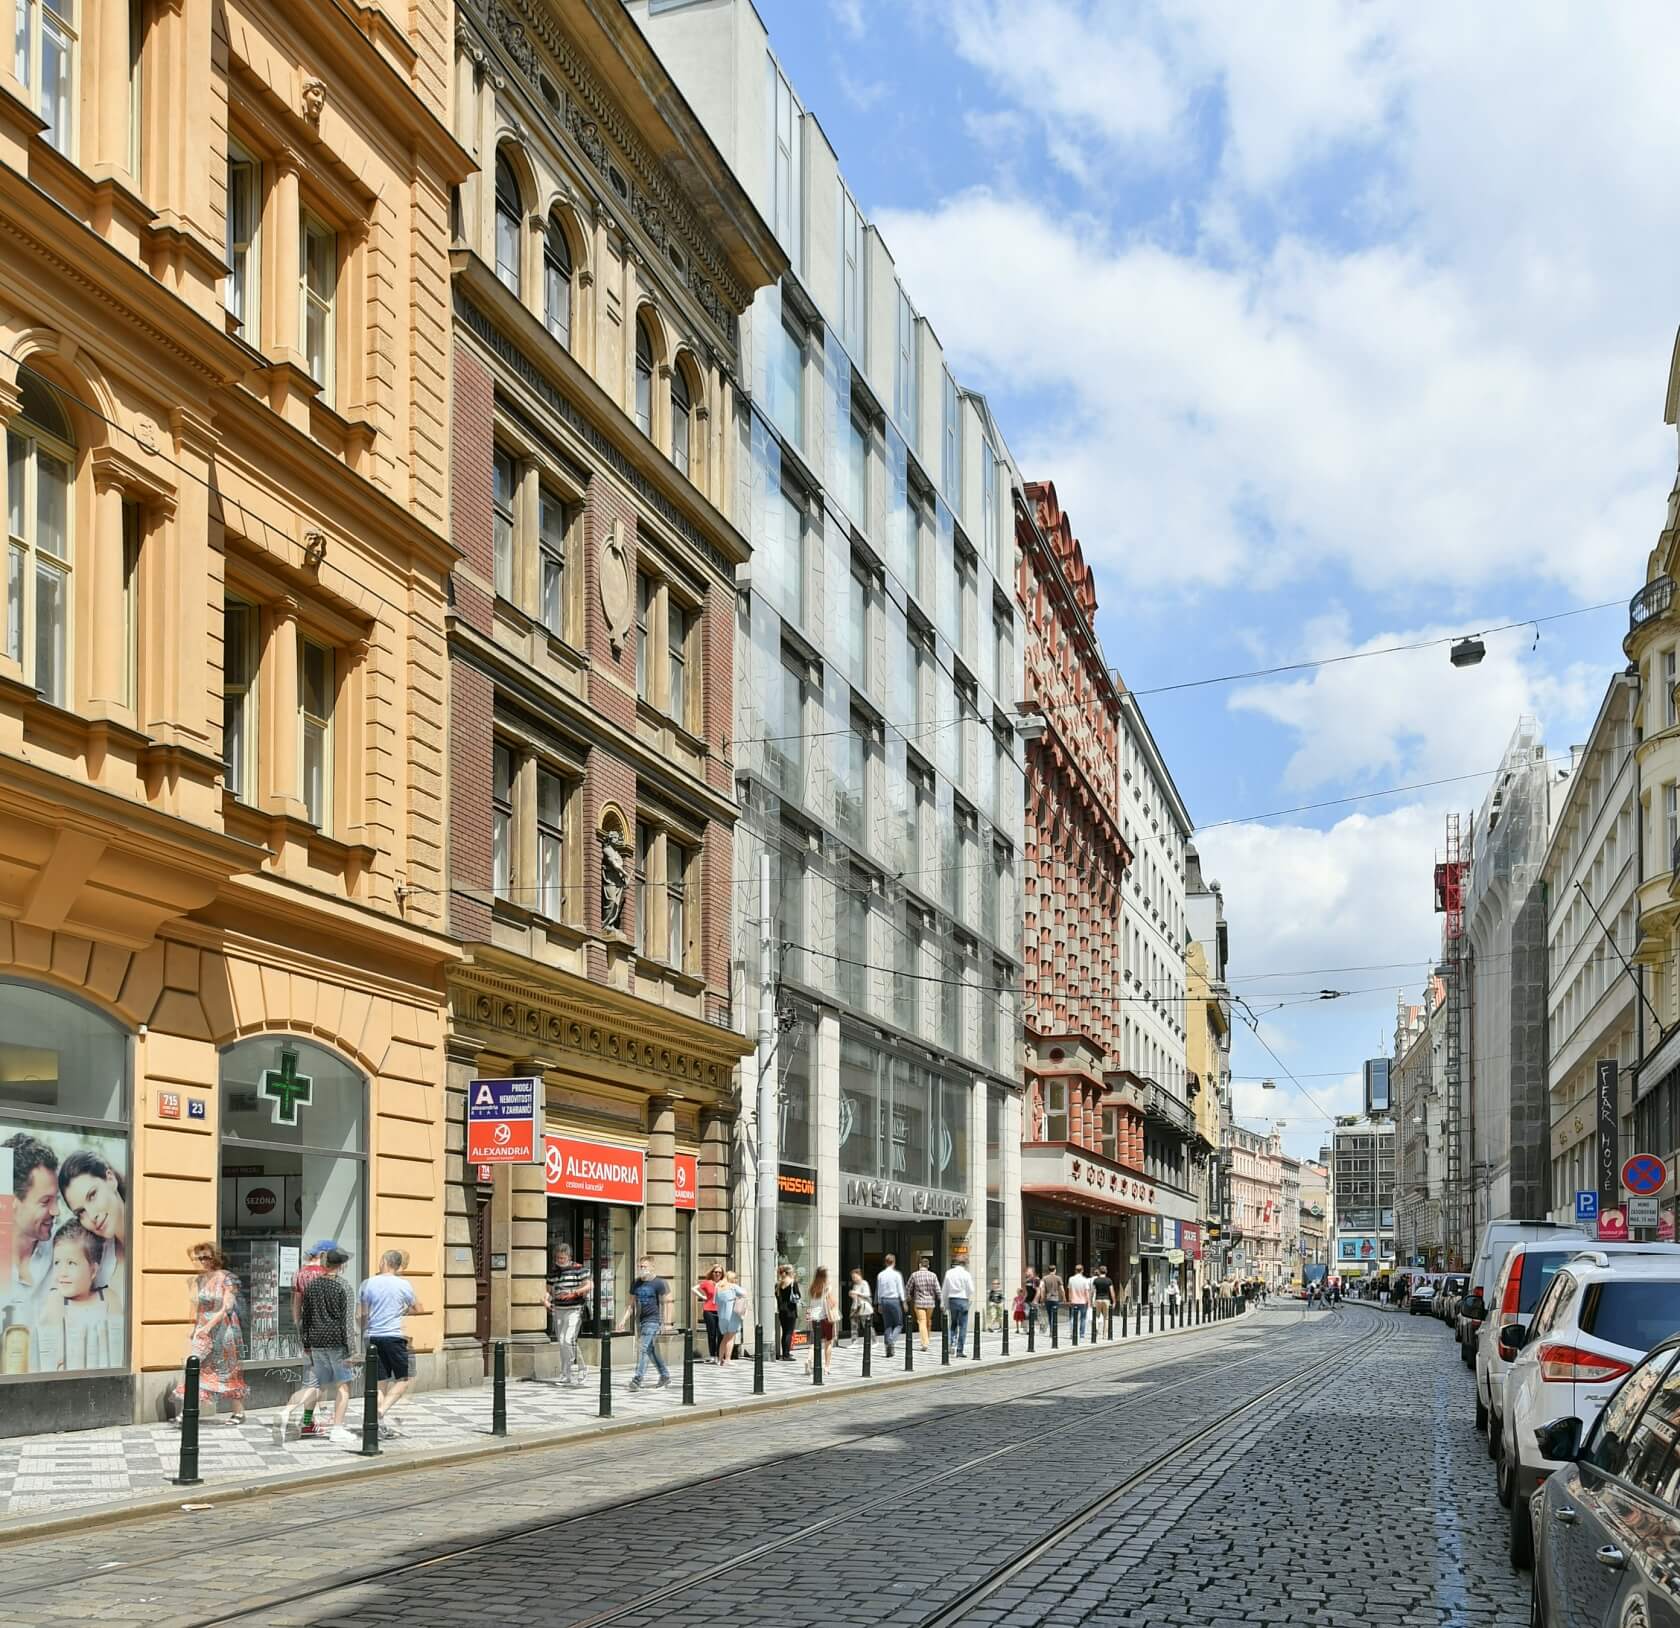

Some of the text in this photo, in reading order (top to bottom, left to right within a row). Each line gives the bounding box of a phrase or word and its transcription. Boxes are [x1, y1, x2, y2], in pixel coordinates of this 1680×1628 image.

[511, 1082, 533, 1092] PRODEJ
[163, 1095, 178, 1106] 715
[499, 1094, 533, 1104] NEMOVITOSTI
[192, 1103, 203, 1114] 23
[472, 1146, 530, 1156] ALEXANDRIA
[1602, 1133, 1612, 1191] HOUSE
[566, 1155, 639, 1185] ALEXANDRIA
[1580, 1194, 1594, 1211] P
